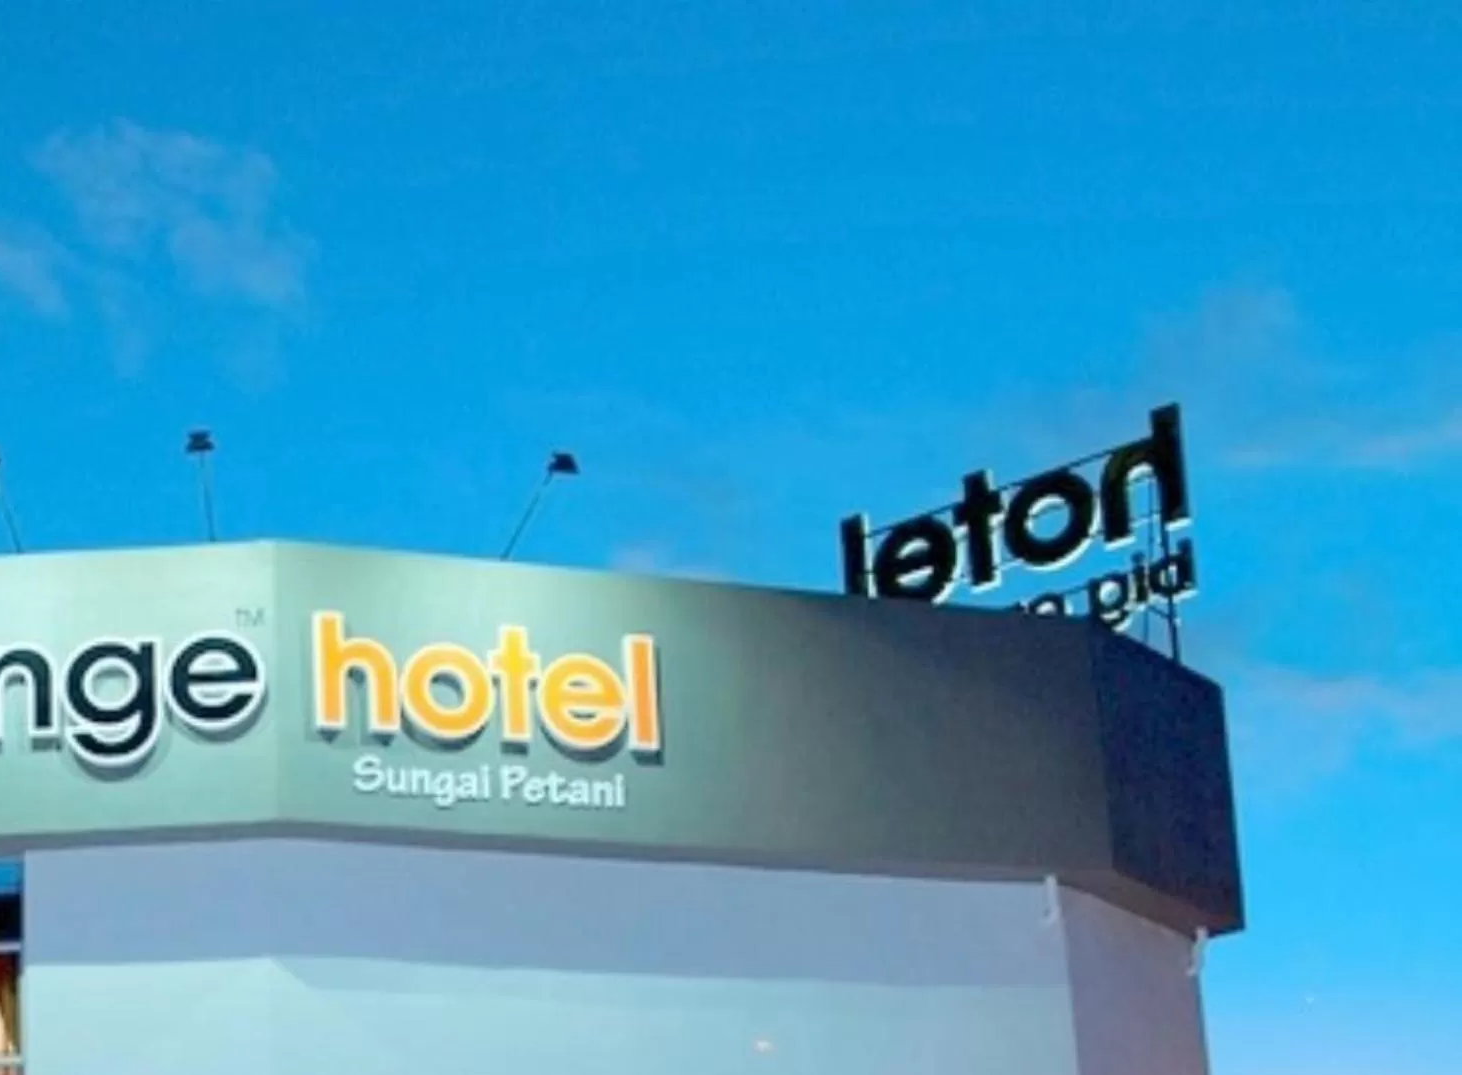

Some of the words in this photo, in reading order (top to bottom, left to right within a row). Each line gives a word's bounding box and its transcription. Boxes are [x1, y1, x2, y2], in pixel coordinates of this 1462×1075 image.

[312, 610, 661, 751] hotel
[352, 753, 490, 808] Sungai
[499, 763, 626, 808] Petani
